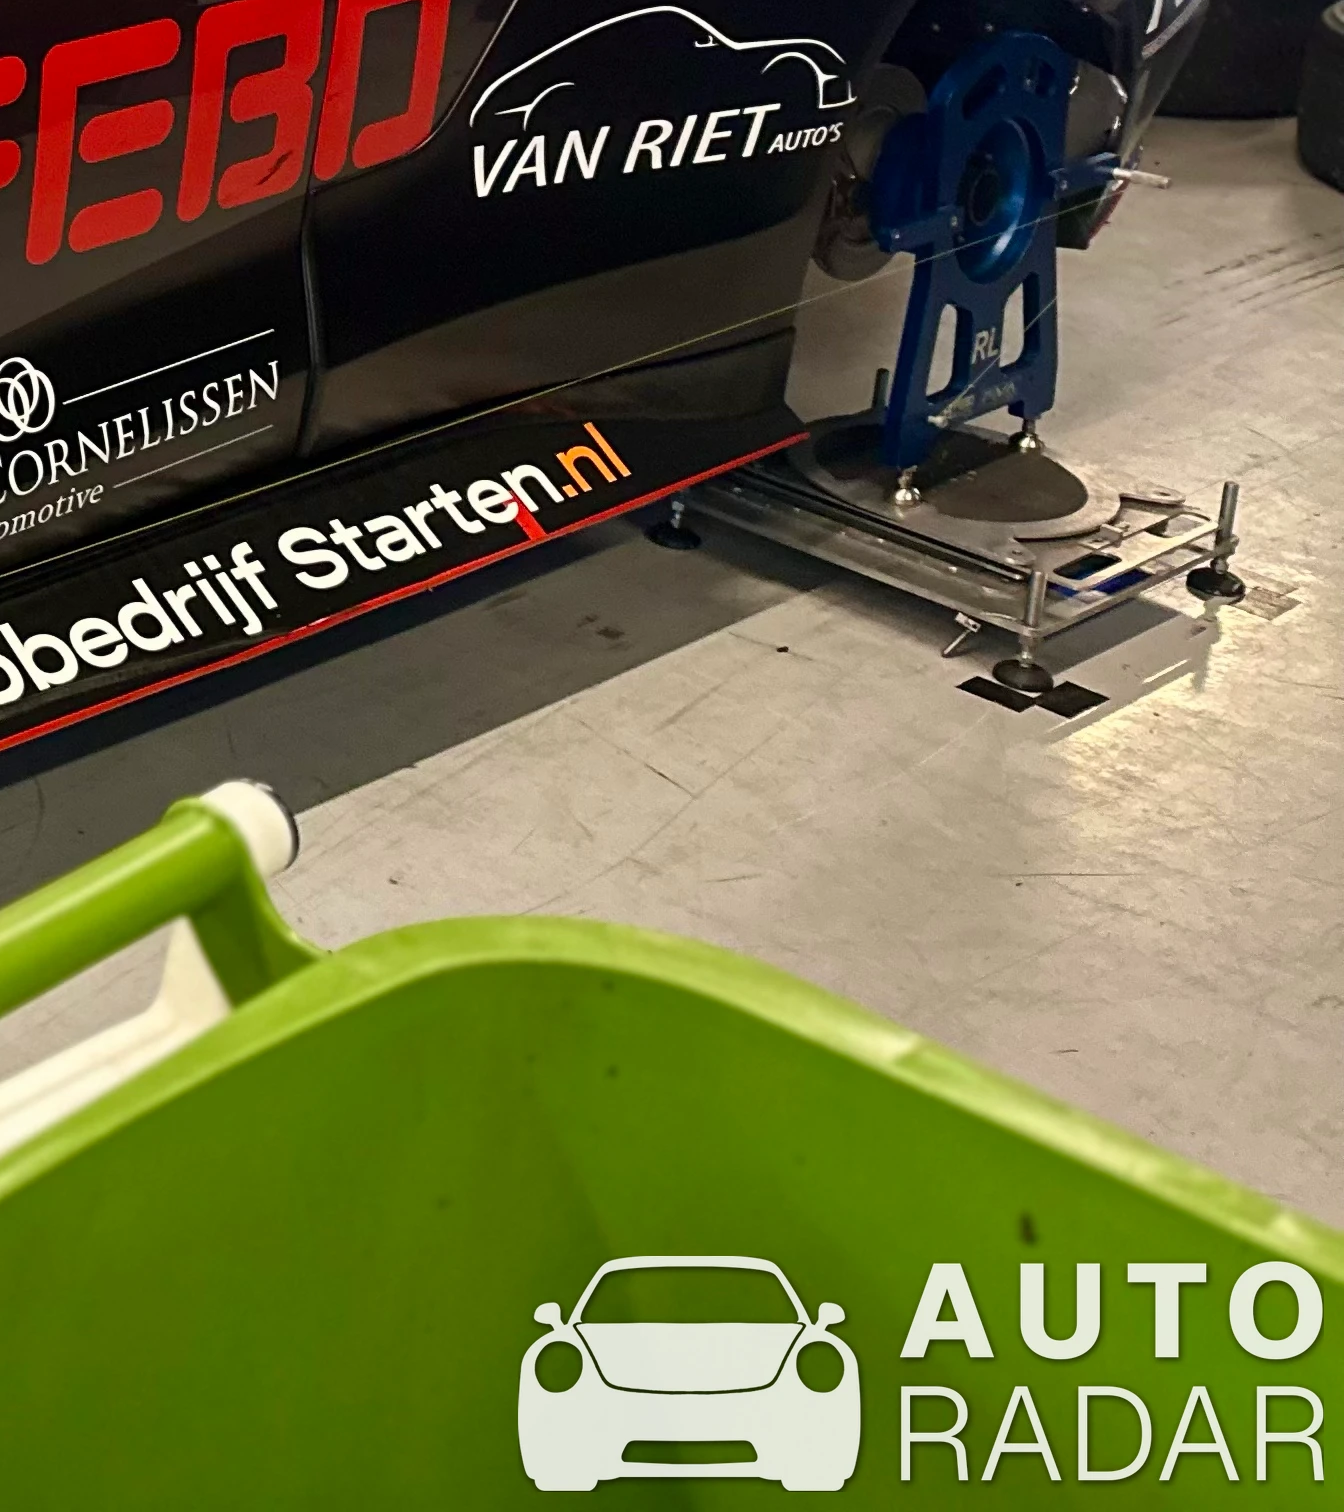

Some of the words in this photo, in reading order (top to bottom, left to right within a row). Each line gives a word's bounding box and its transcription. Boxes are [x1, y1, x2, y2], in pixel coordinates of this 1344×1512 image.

[471, 126, 608, 198] VAN
[625, 103, 781, 175] RIET
[767, 119, 844, 154] AUTO'S
[972, 327, 999, 364] RL
[282, 422, 634, 591] Starten.nl
